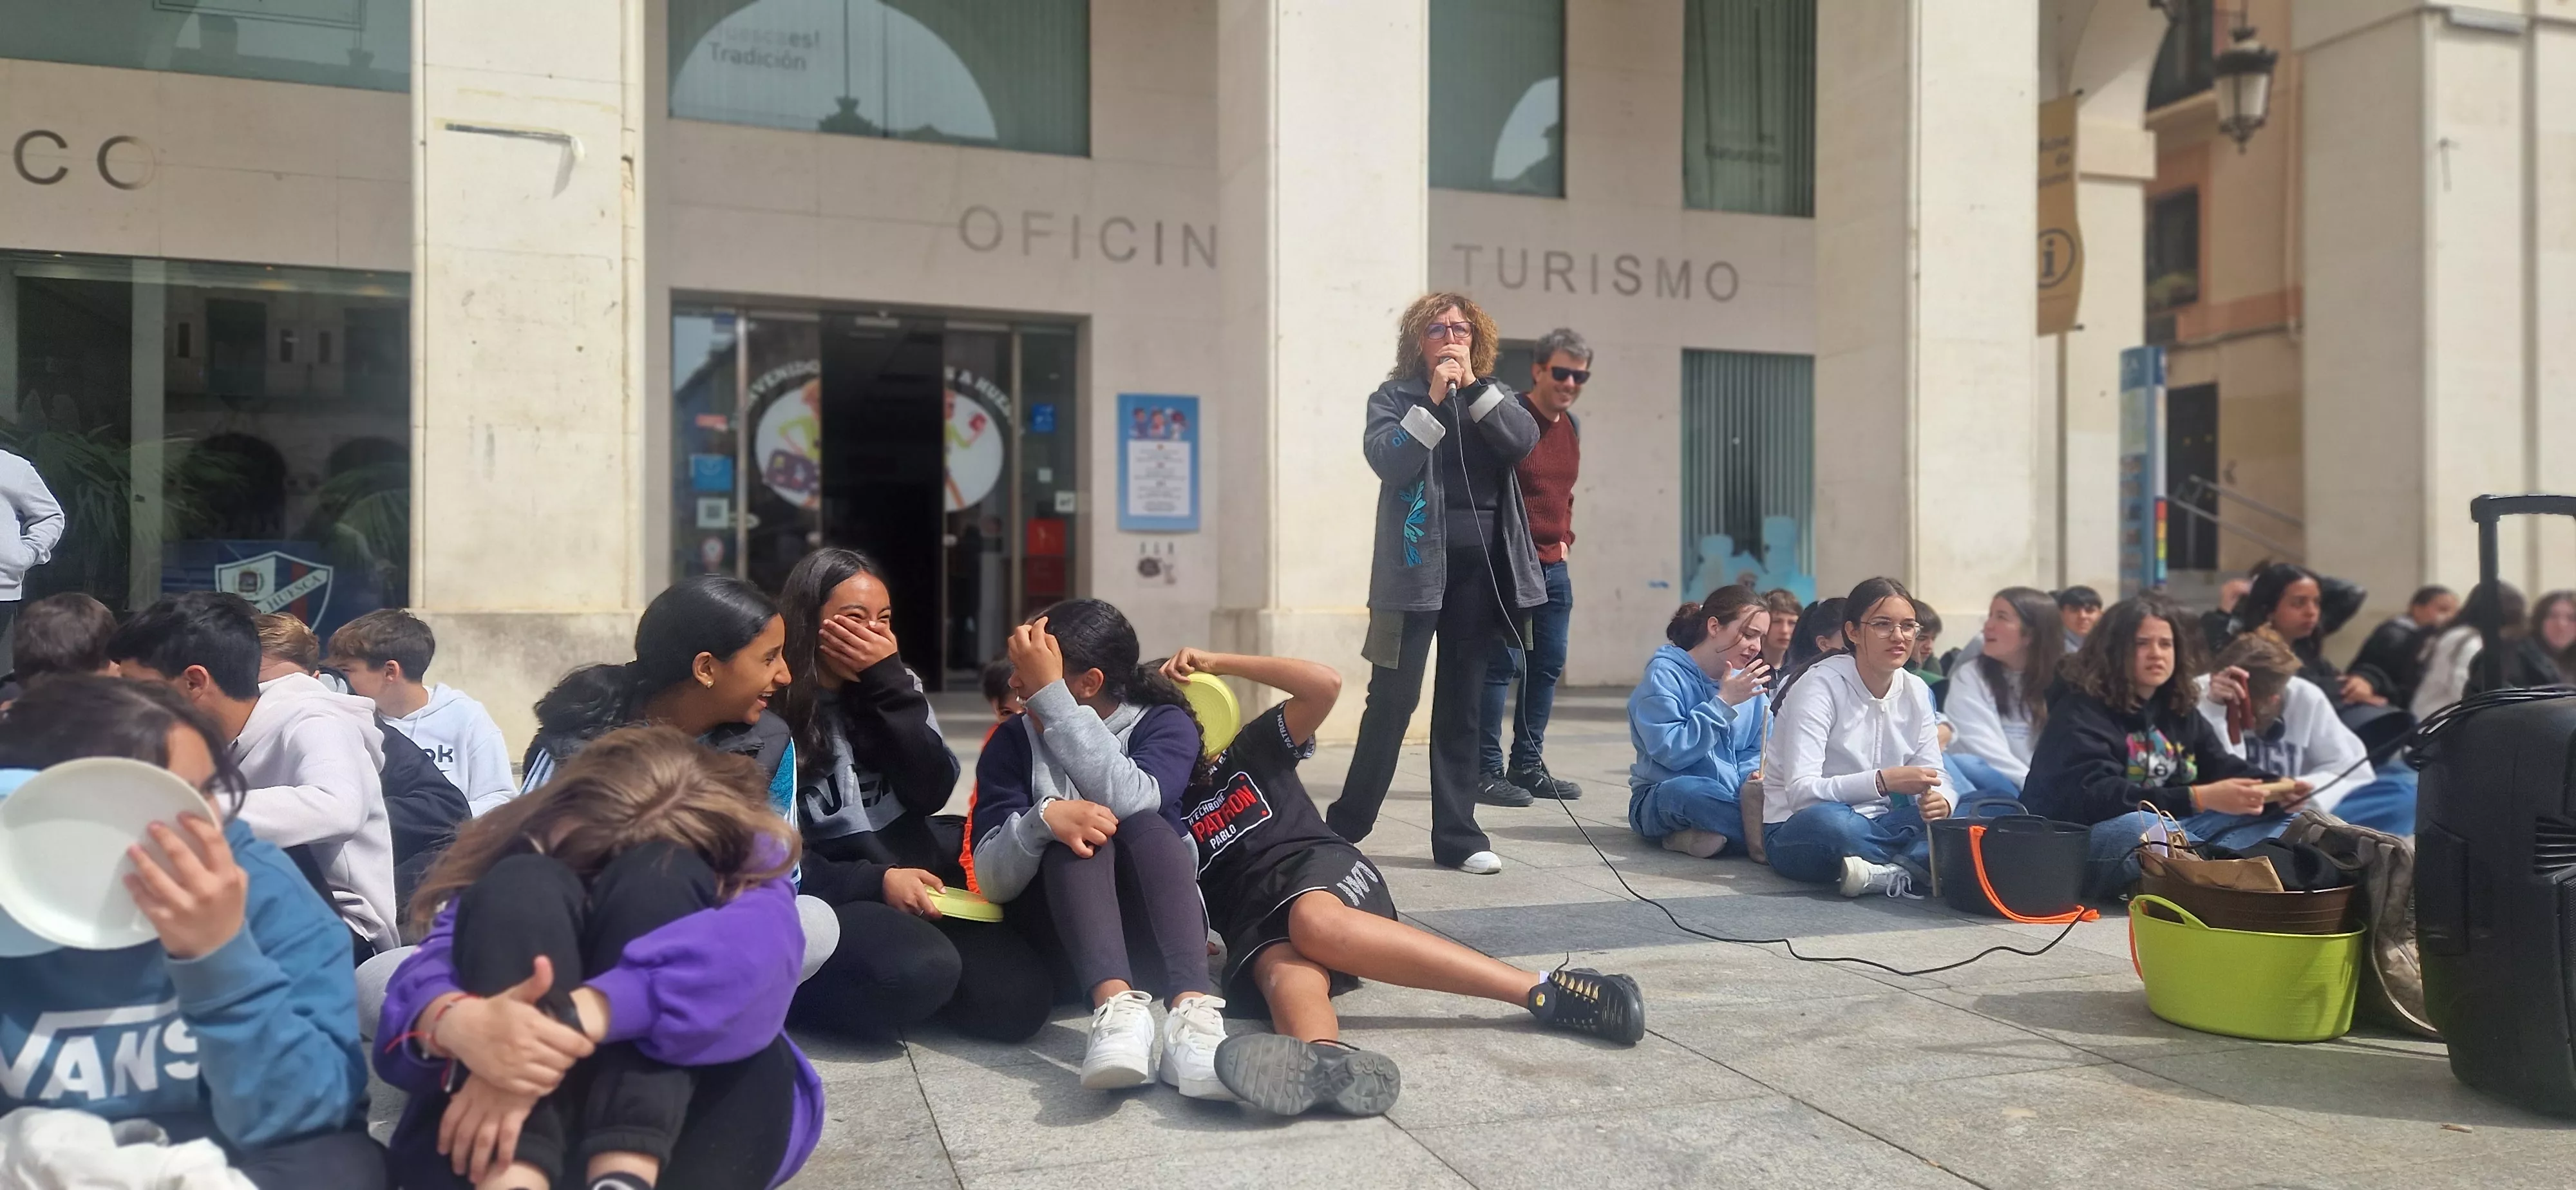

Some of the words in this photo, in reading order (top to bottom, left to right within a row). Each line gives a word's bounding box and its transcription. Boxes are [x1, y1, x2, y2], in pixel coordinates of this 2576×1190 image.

[708, 42, 807, 71] Tradición
[958, 203, 1217, 269] OFICIN
[1452, 243, 1740, 303] TURISMO
[266, 575, 322, 610] HUESCA
[1276, 714, 1294, 749] PATRON
[1189, 792, 1226, 826] H'ECHBONE
[1192, 785, 1258, 843] PATRON
[1209, 824, 1237, 849] PABLO
[0, 996, 199, 1100] VANS
